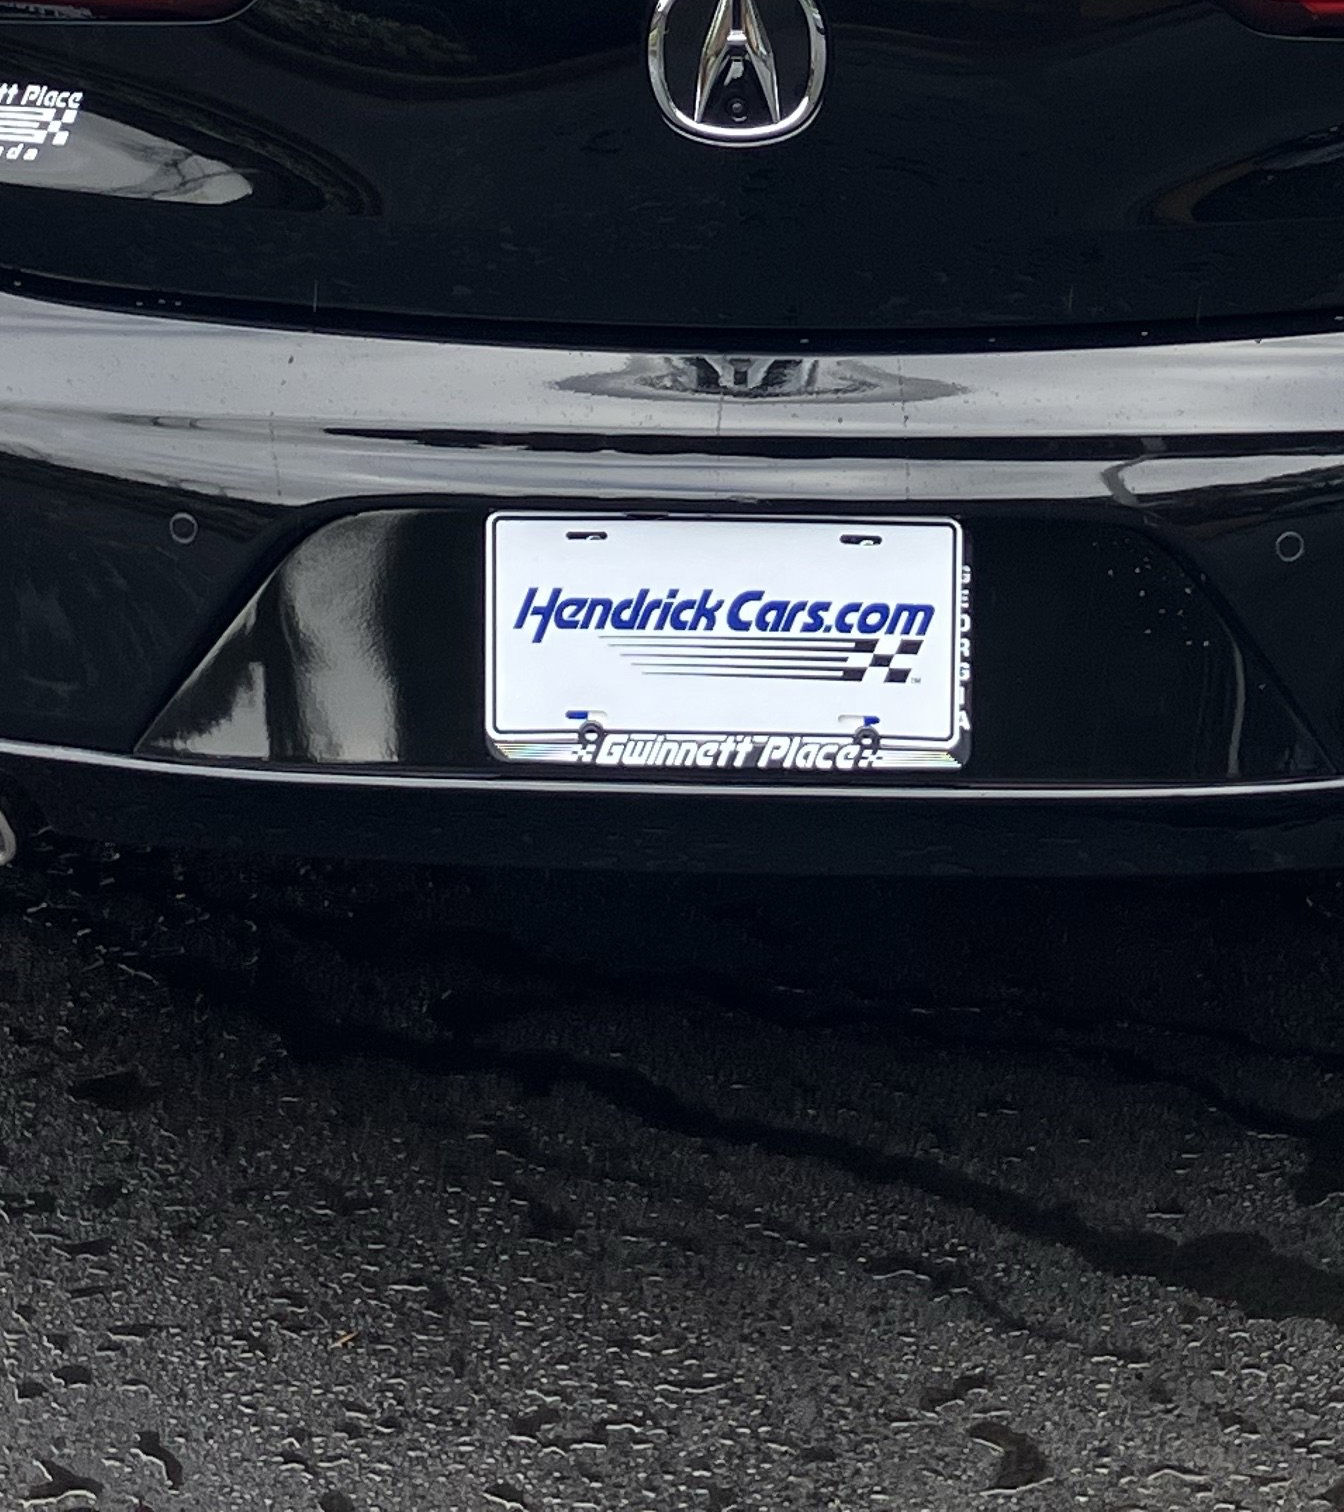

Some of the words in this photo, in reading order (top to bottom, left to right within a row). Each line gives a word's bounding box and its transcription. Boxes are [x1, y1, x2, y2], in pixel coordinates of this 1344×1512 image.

[20, 84, 84, 108] Place
[596, 734, 756, 769] Gwinnett
[757, 735, 860, 771] Place
